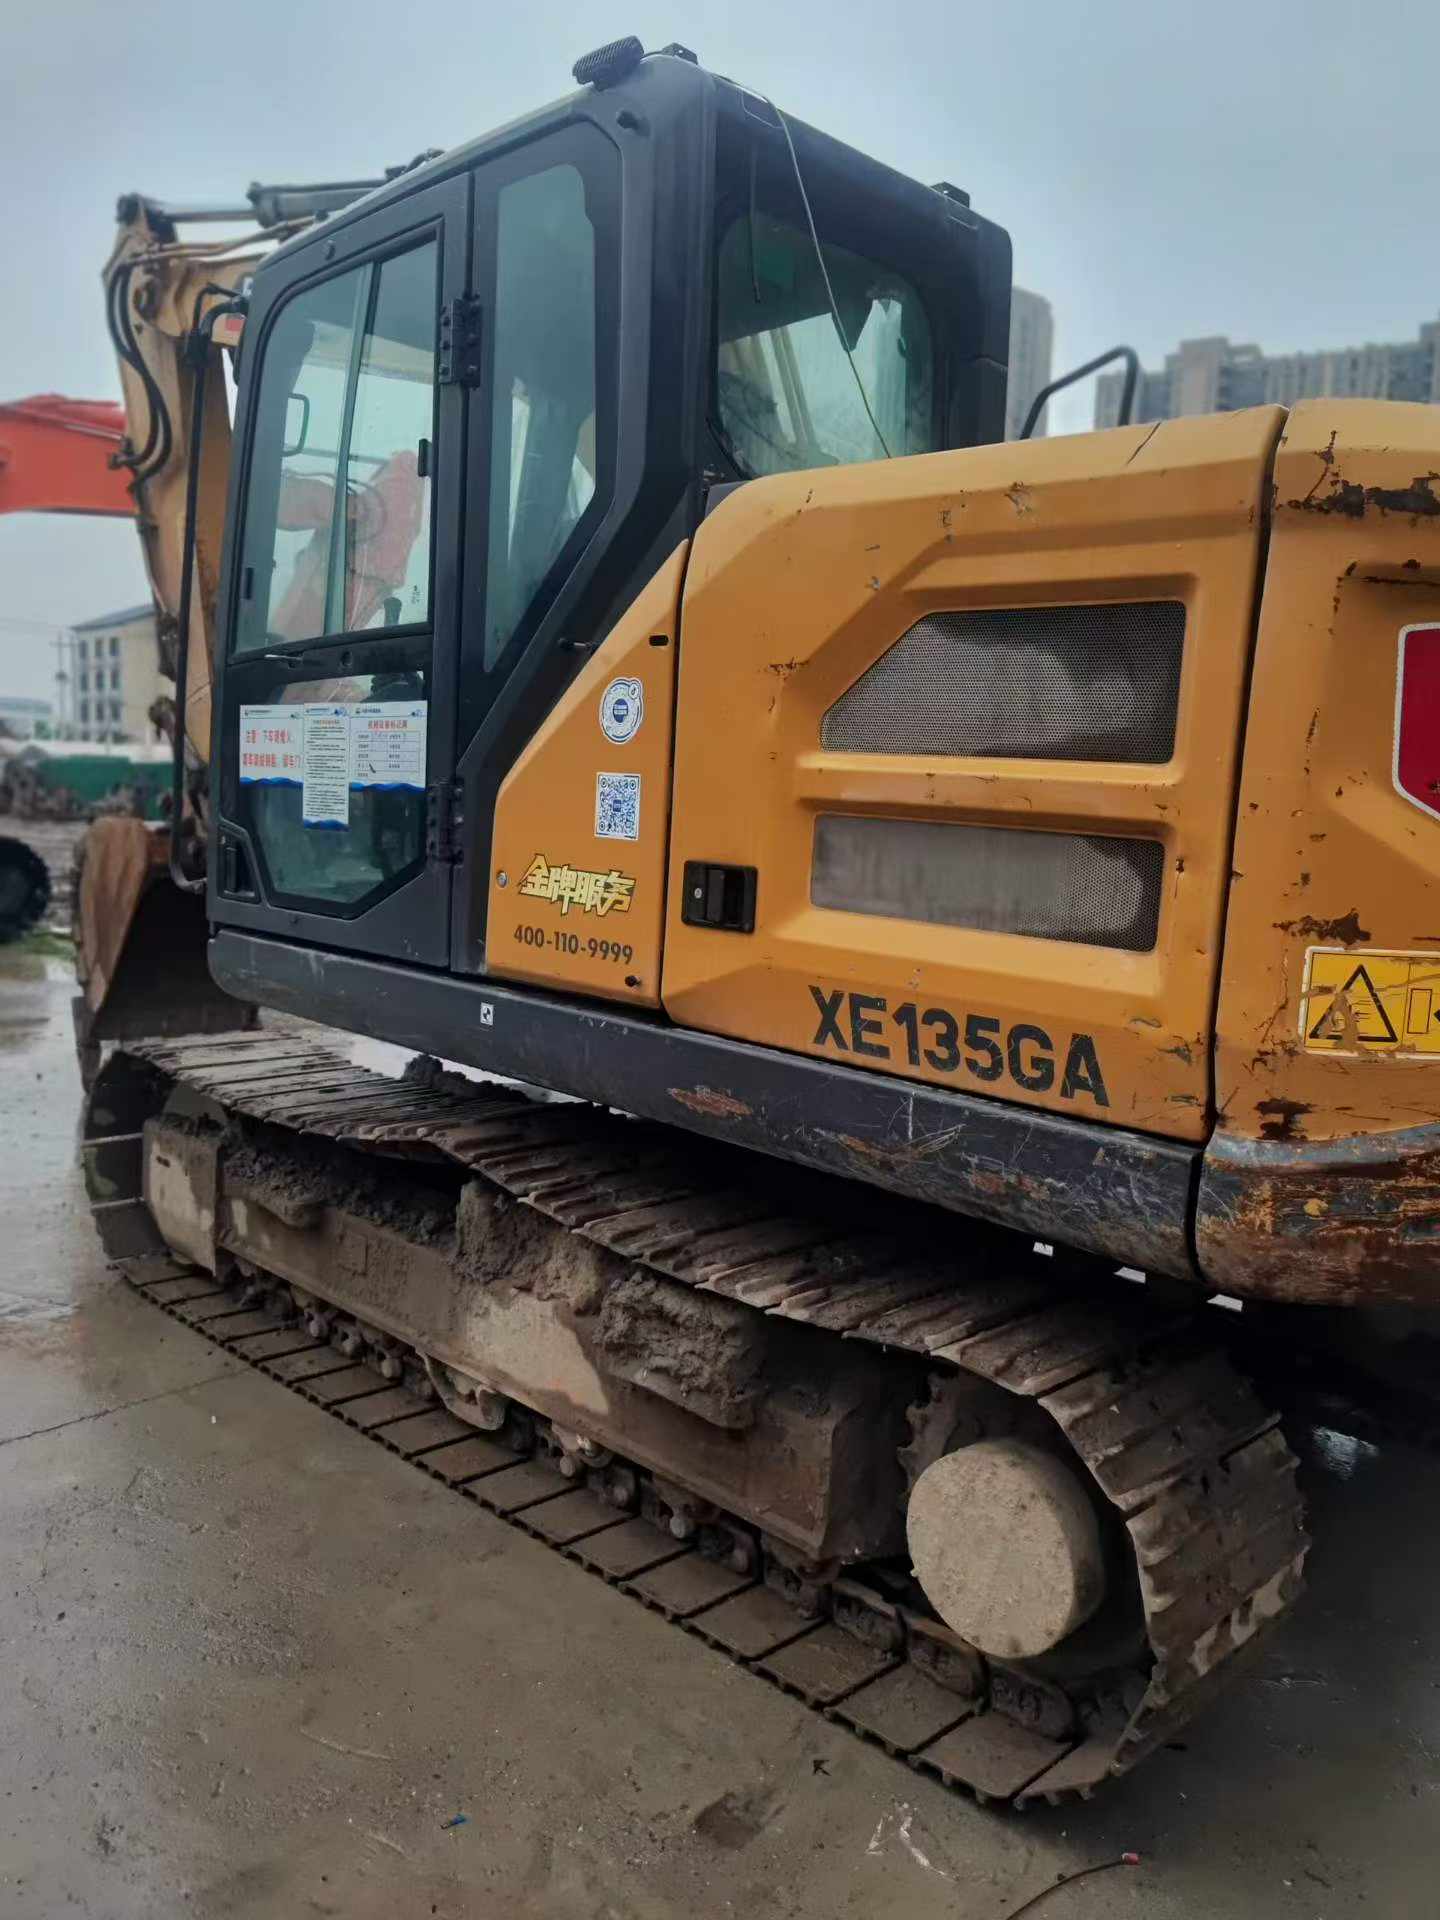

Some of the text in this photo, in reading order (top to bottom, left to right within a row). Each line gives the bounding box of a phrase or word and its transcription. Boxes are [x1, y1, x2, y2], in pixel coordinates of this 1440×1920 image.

[518, 853, 636, 917] 金牌服务
[514, 924, 633, 965] 400-110-9999
[808, 984, 1110, 1107] XE135GA
